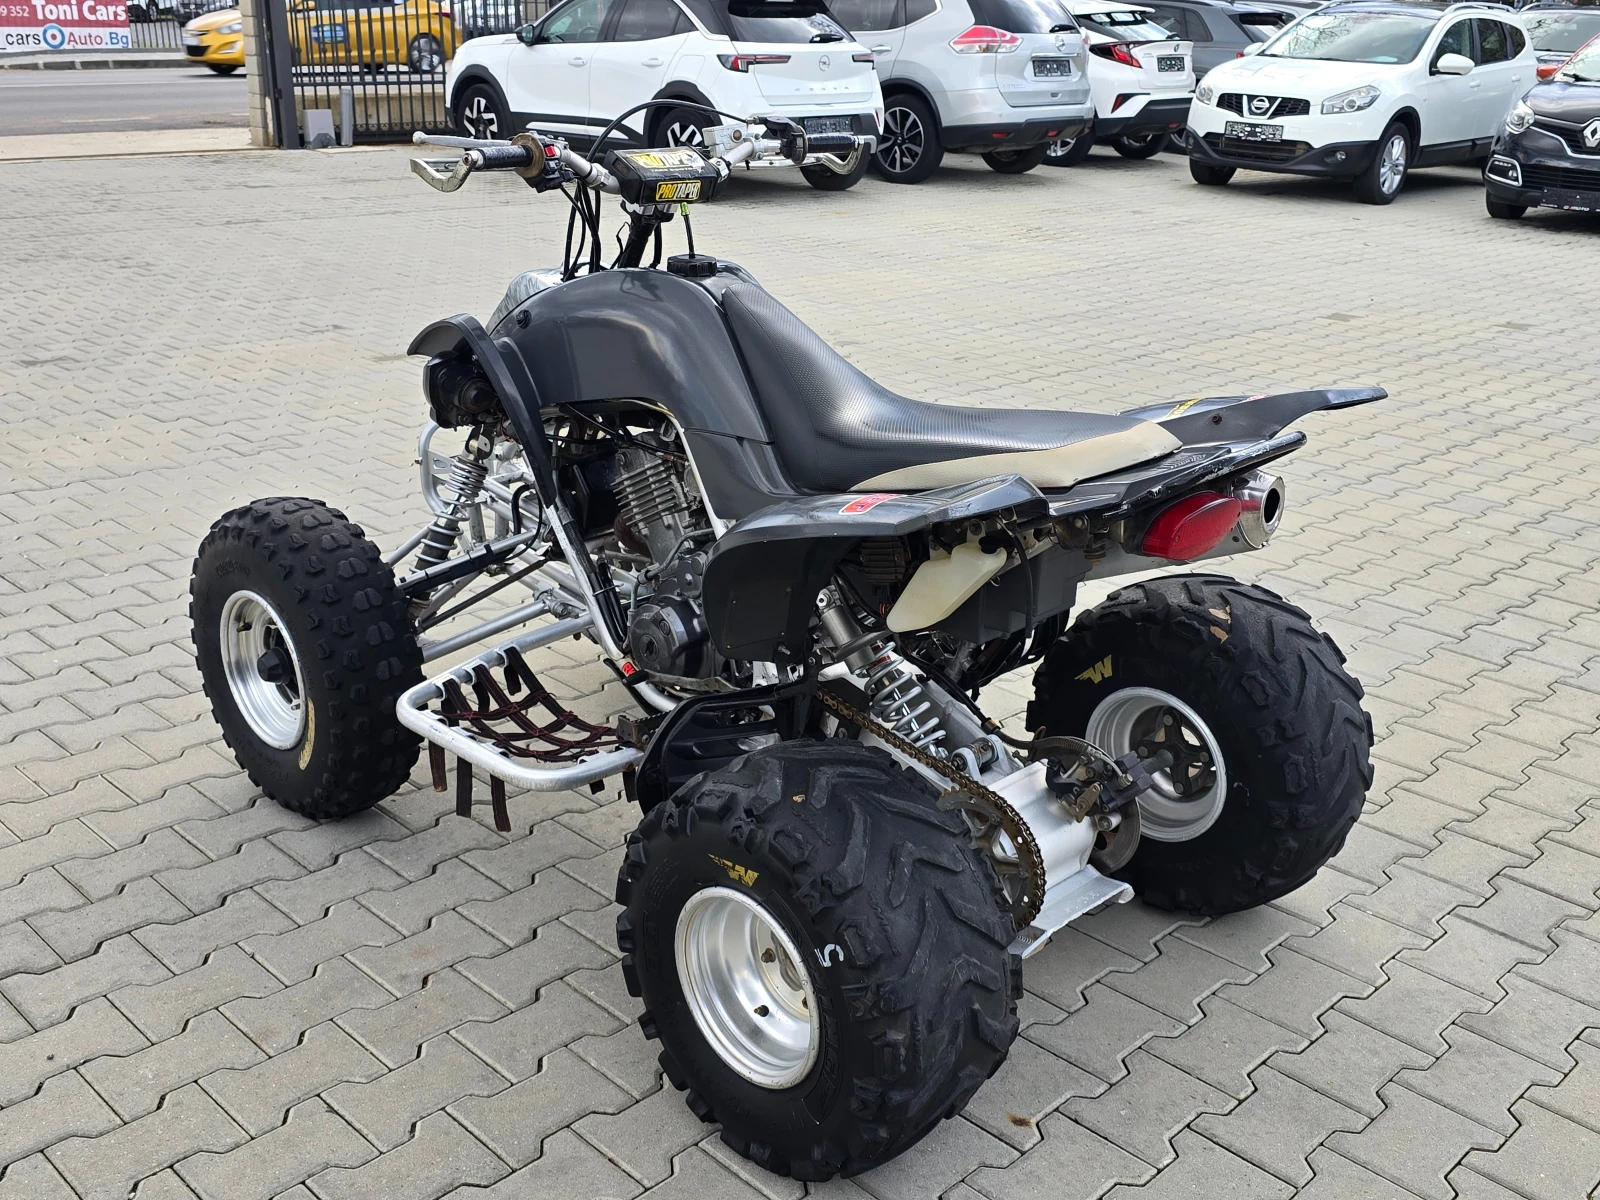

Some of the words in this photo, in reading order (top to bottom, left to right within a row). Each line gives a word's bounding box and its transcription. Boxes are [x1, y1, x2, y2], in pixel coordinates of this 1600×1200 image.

[10, 6, 30, 17] 352
[31, 0, 79, 20] Toni
[82, 0, 127, 20] Cars
[66, 31, 130, 49] Auto.Bg
